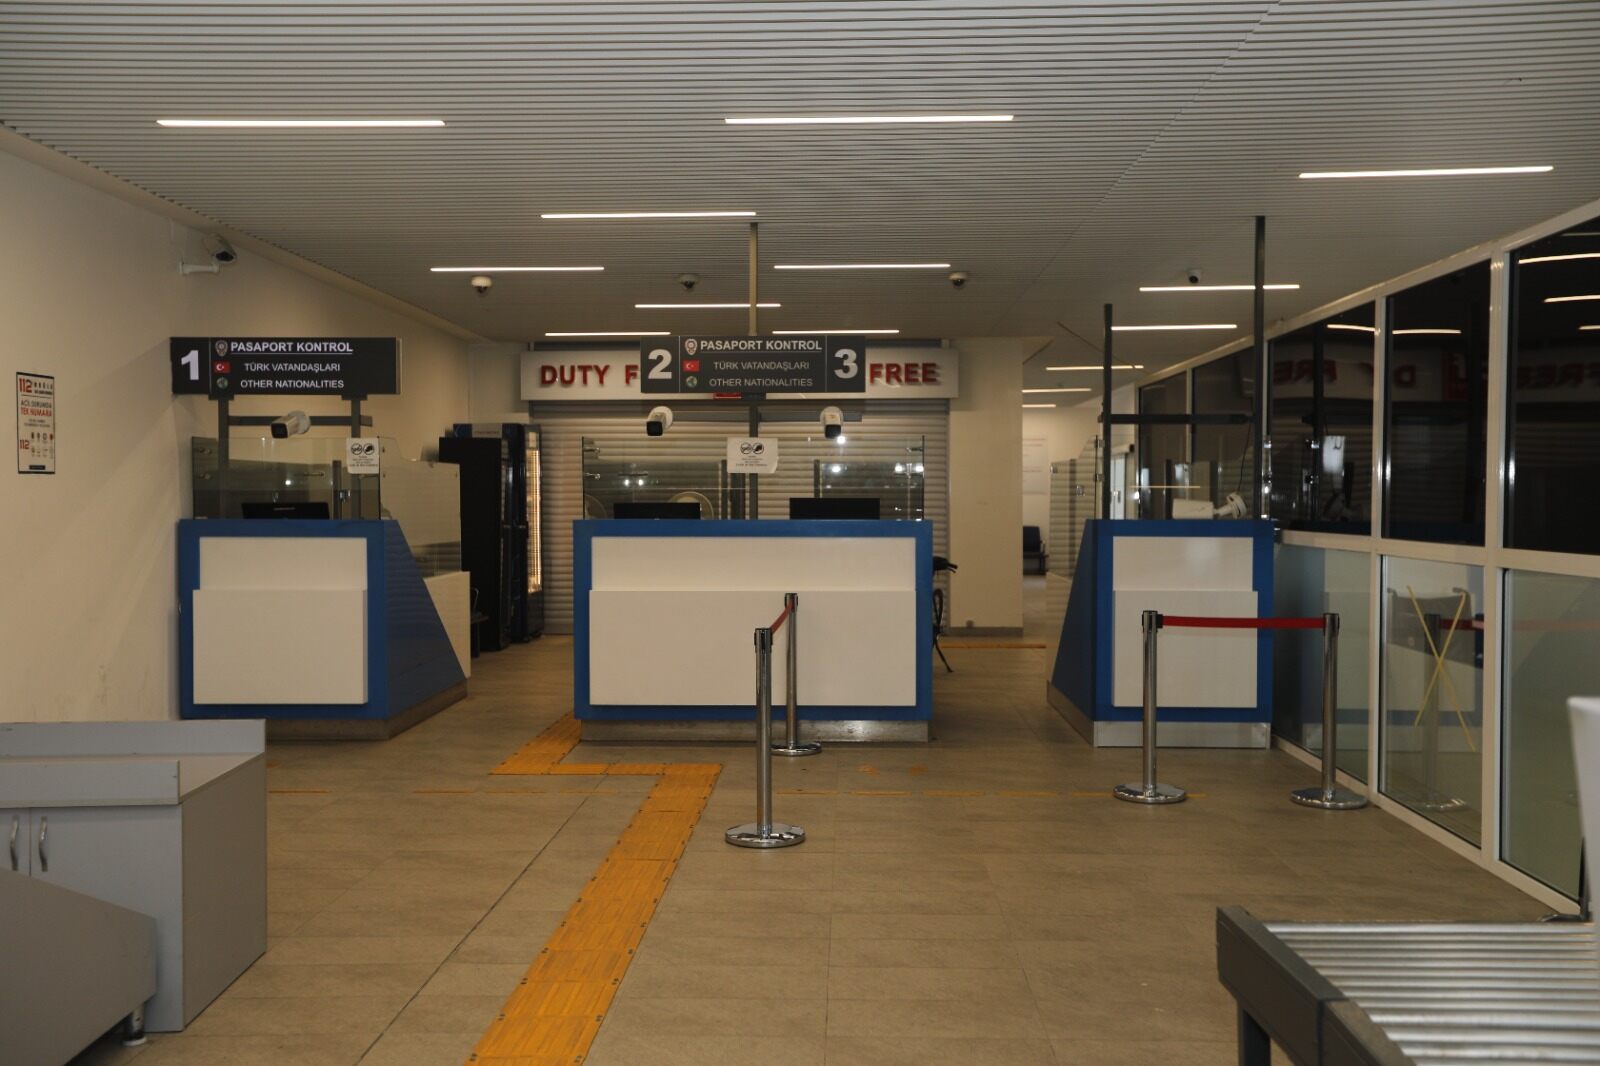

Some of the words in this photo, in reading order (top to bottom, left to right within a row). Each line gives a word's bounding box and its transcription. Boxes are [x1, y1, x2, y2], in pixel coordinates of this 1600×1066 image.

[230, 341, 293, 353] PASAPORT
[296, 341, 354, 353] KONTROL
[700, 340, 763, 351] PASAPORT
[765, 340, 823, 351] KONTROL
[180, 349, 200, 381] 1
[243, 361, 270, 372] TÜRK
[271, 361, 341, 374] VATANDAŞLARI
[647, 348, 673, 380] 2
[713, 360, 738, 371] TÜRK
[740, 360, 810, 372] VATANDAŞLARI
[833, 348, 859, 379] 3
[540, 364, 611, 386] DUTY
[868, 363, 938, 385] FREE
[19, 378, 32, 393] 112
[240, 379, 273, 389] OTHER
[275, 379, 345, 389] NATIONALITIES
[708, 378, 742, 387] OTHER
[744, 378, 814, 387] NATIONALITIES
[19, 439, 29, 449] 112
